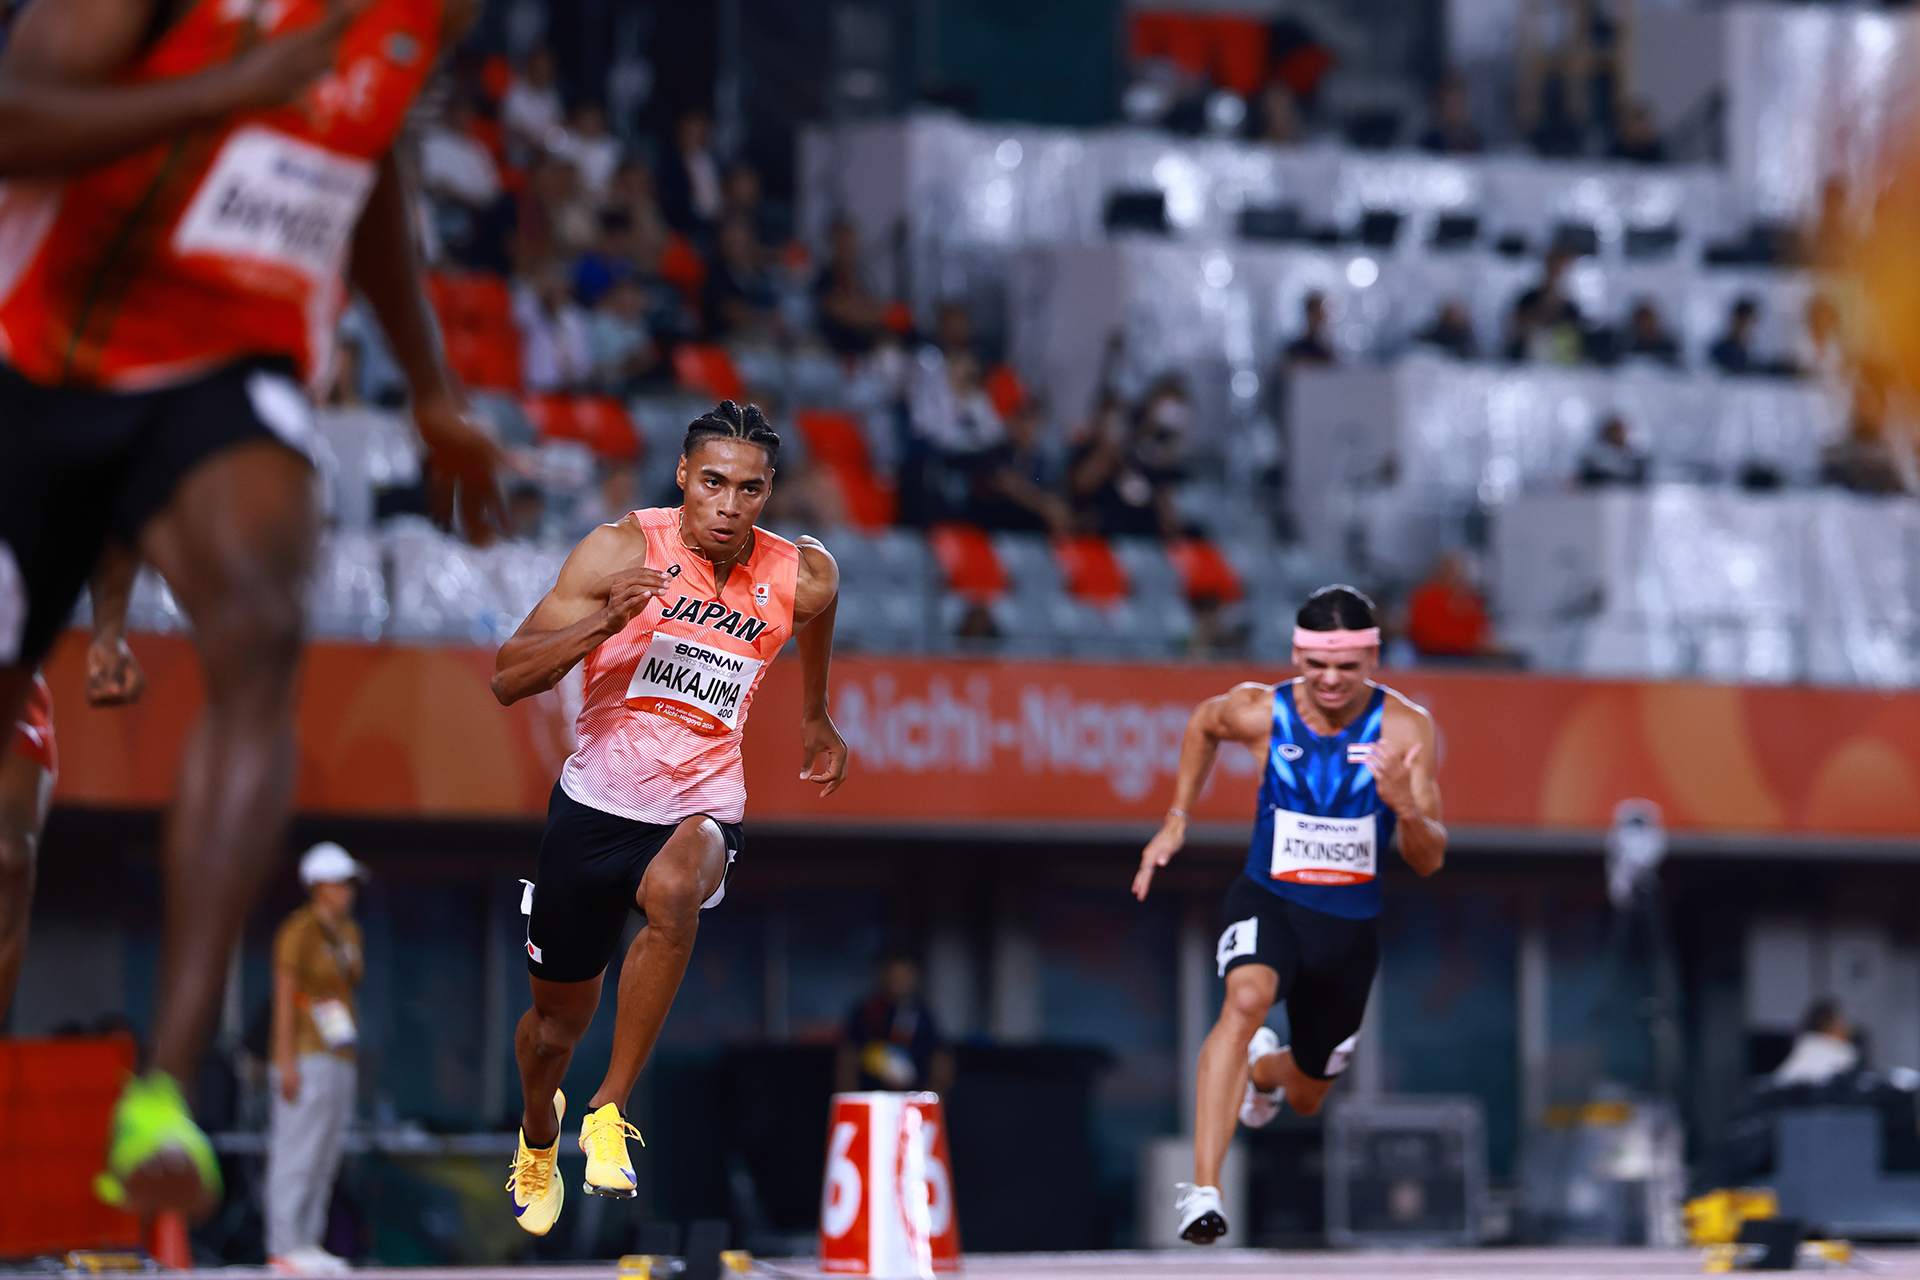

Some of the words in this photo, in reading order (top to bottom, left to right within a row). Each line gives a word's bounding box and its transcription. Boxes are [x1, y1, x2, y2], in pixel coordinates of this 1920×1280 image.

[662, 595, 767, 643] JAPAN
[672, 653, 697, 666] SPORTS
[698, 662, 738, 679] TECHNOLOGY
[674, 643, 744, 672] BORNAN
[642, 657, 741, 708] NAKAJIMA
[717, 708, 733, 719] 400
[834, 676, 1256, 804] Aichi-Nago
[1282, 837, 1371, 862] ATKINSON
[1223, 928, 1238, 952] 4
[820, 1120, 863, 1240] 6
[902, 1120, 952, 1239] 6
